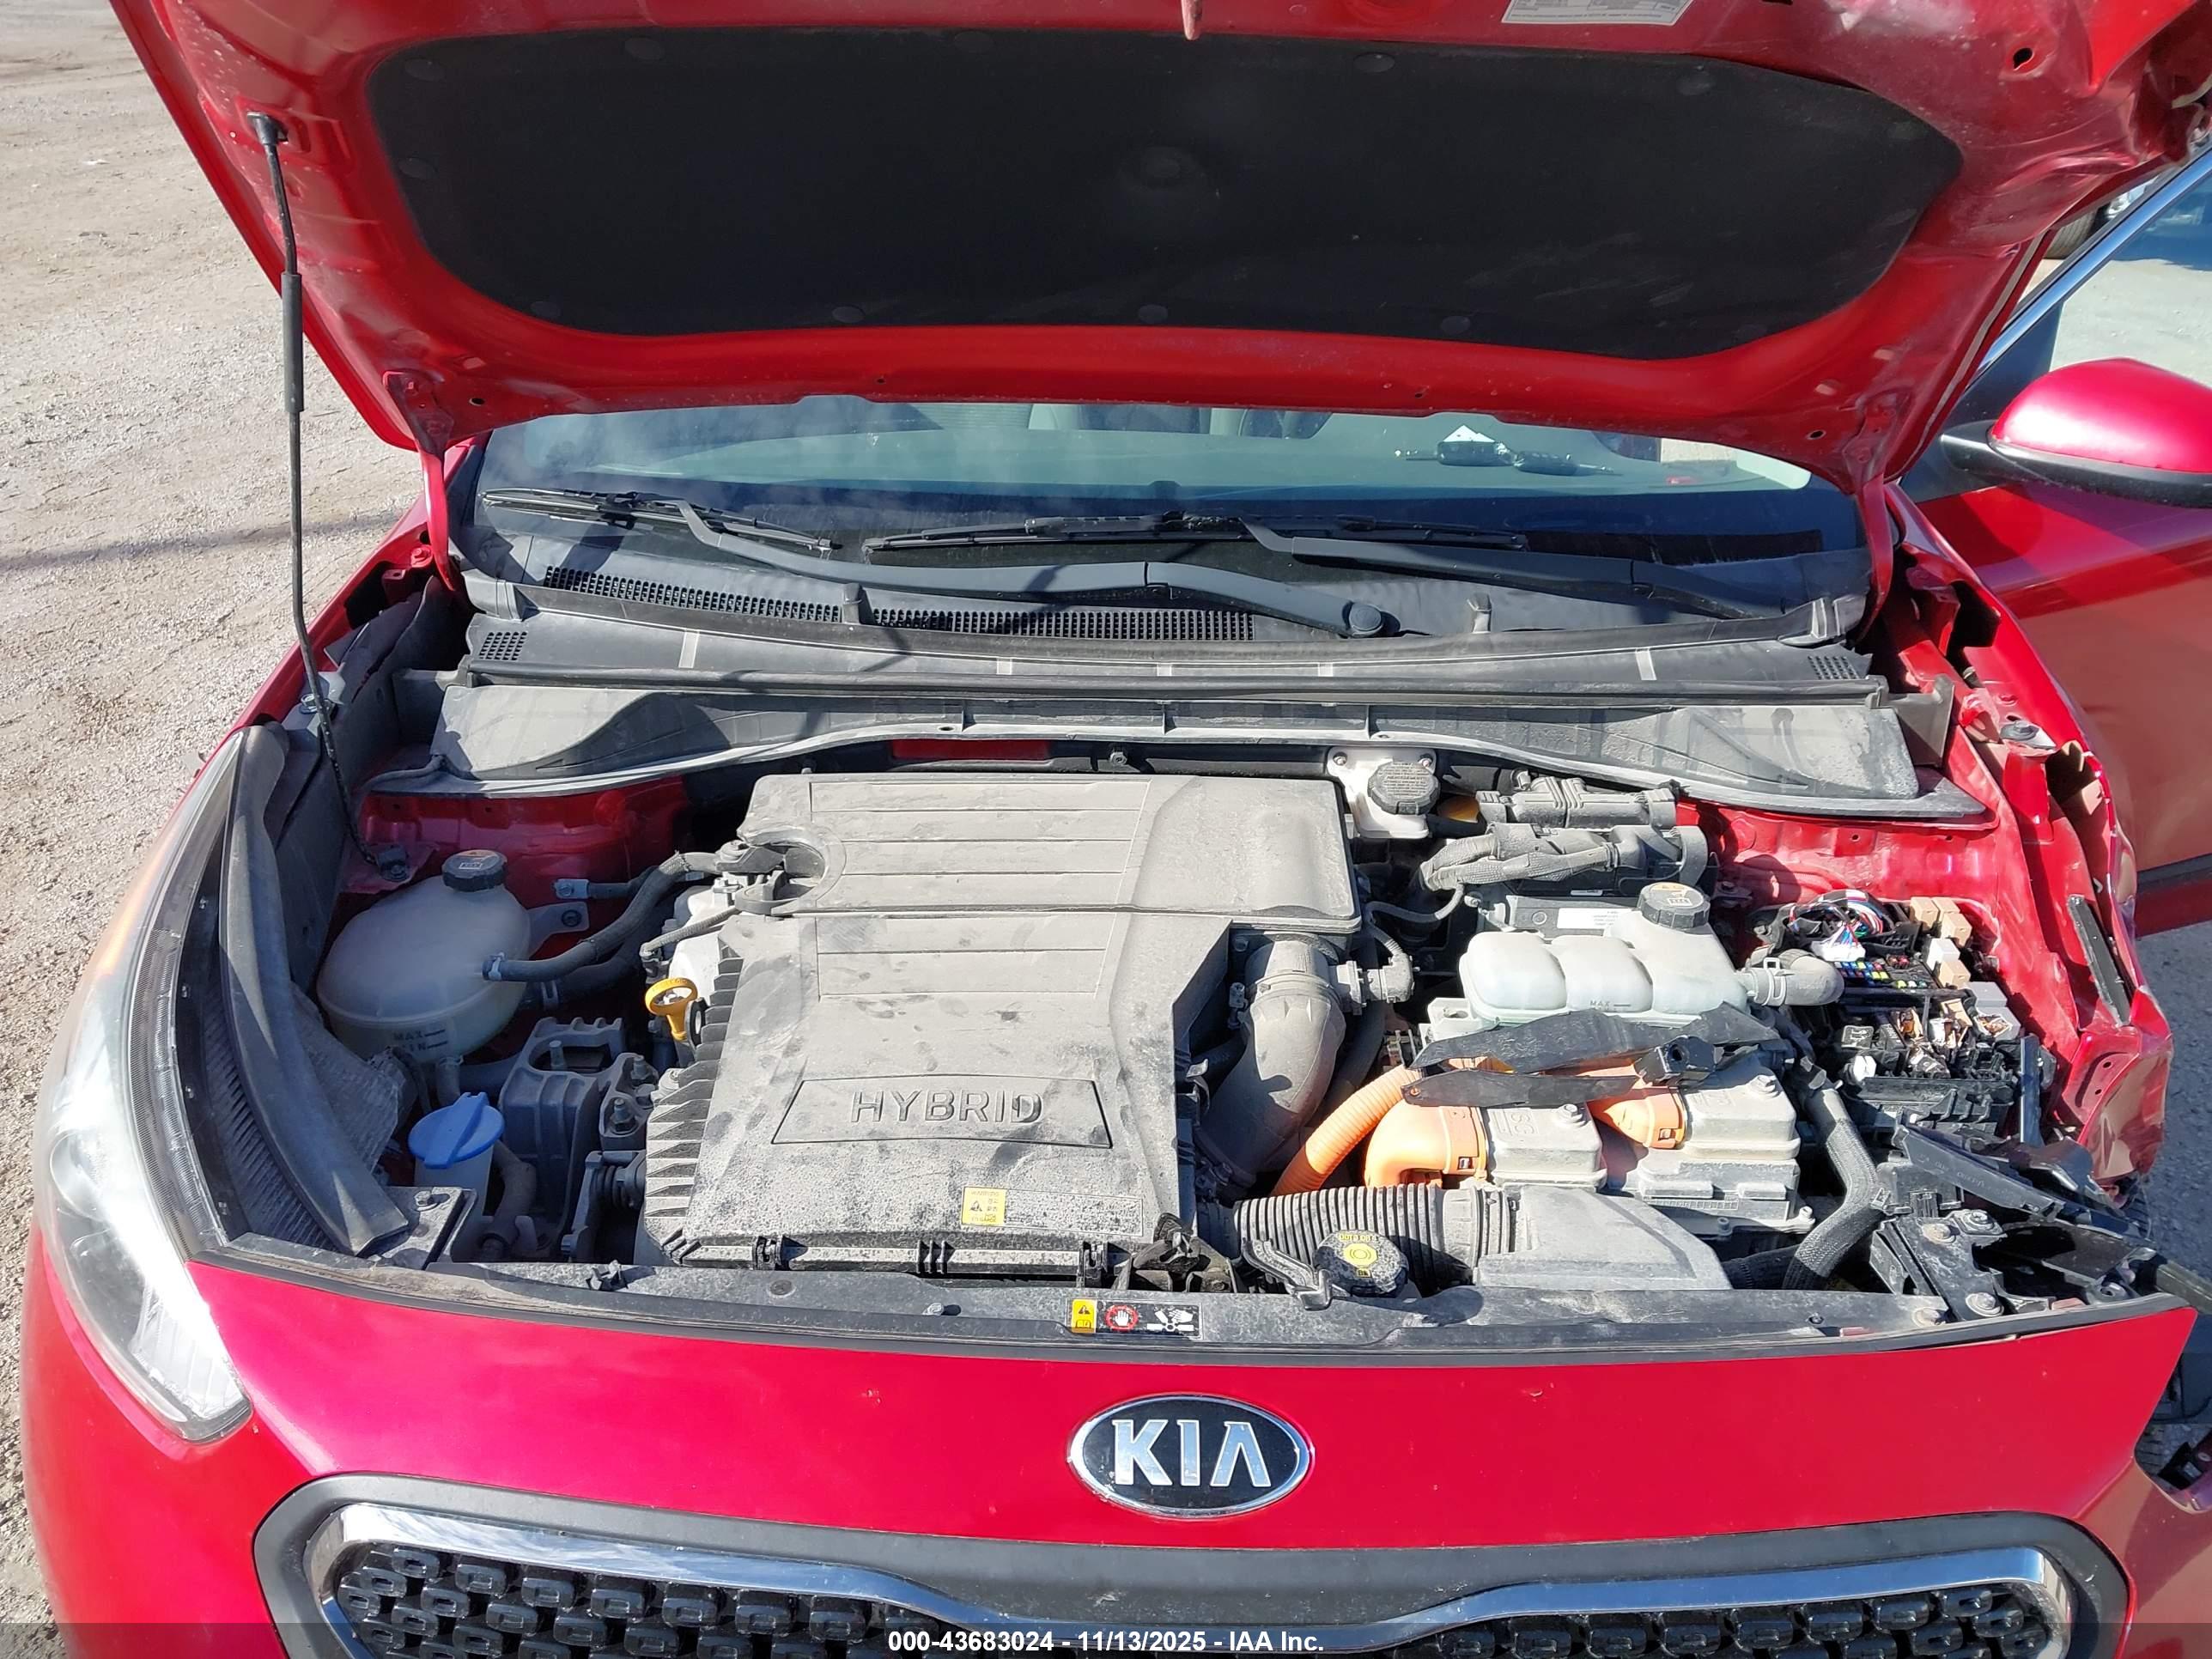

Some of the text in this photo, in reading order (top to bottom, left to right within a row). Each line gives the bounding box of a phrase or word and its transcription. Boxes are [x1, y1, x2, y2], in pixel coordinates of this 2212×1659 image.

[393, 1030, 423, 1041] MAX
[851, 1090, 1043, 1124] HYBRID
[1112, 1419, 1272, 1487] KIA
